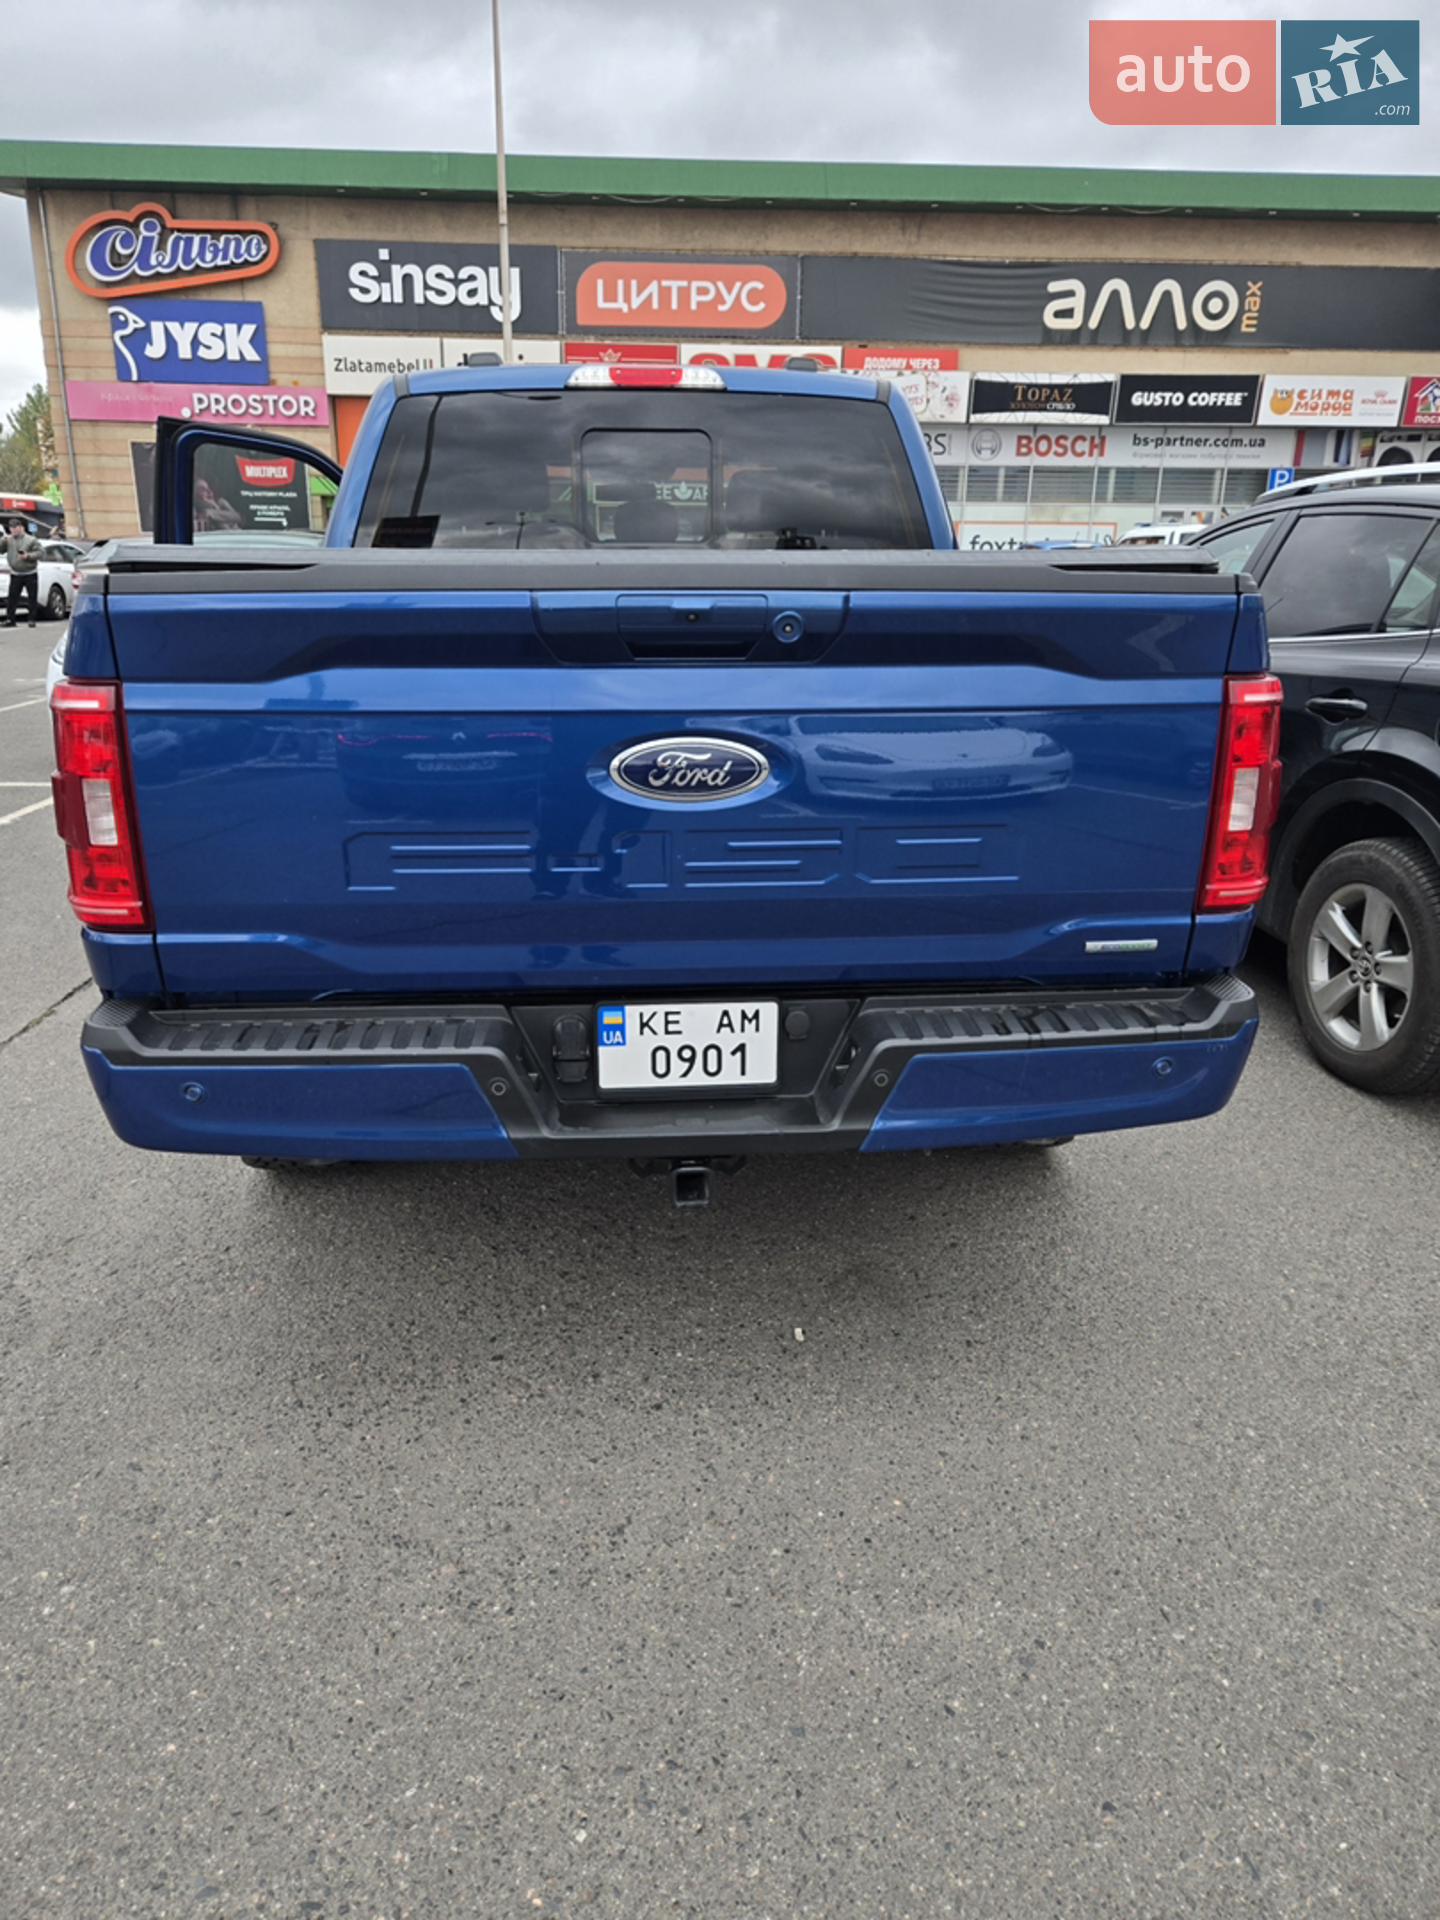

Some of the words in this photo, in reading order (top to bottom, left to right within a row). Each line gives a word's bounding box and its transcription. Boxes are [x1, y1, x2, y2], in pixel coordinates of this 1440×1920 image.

[85, 218, 267, 282] Сільпо
[348, 248, 521, 323] sinsay
[596, 279, 766, 313] ЦИТРУС
[1240, 280, 1263, 332] max
[144, 322, 262, 362] JYSK
[334, 358, 420, 374] Zlatamebel
[864, 356, 907, 370] ДОДОМУ
[909, 358, 940, 371] ЧЕРЕЗ
[1130, 390, 1185, 406] GUSTO
[1186, 391, 1244, 407] COFFEE
[1015, 434, 1107, 457] BOSCH
[1132, 434, 1266, 449] bs-partner.com.ua
[245, 465, 288, 478] MULTIPLEX
[1276, 471, 1289, 489] P
[648, 751, 733, 786] Ford
[638, 1011, 683, 1036] KE
[716, 1008, 760, 1034] AM
[603, 1031, 623, 1044] UA
[651, 1043, 746, 1078] 0901
